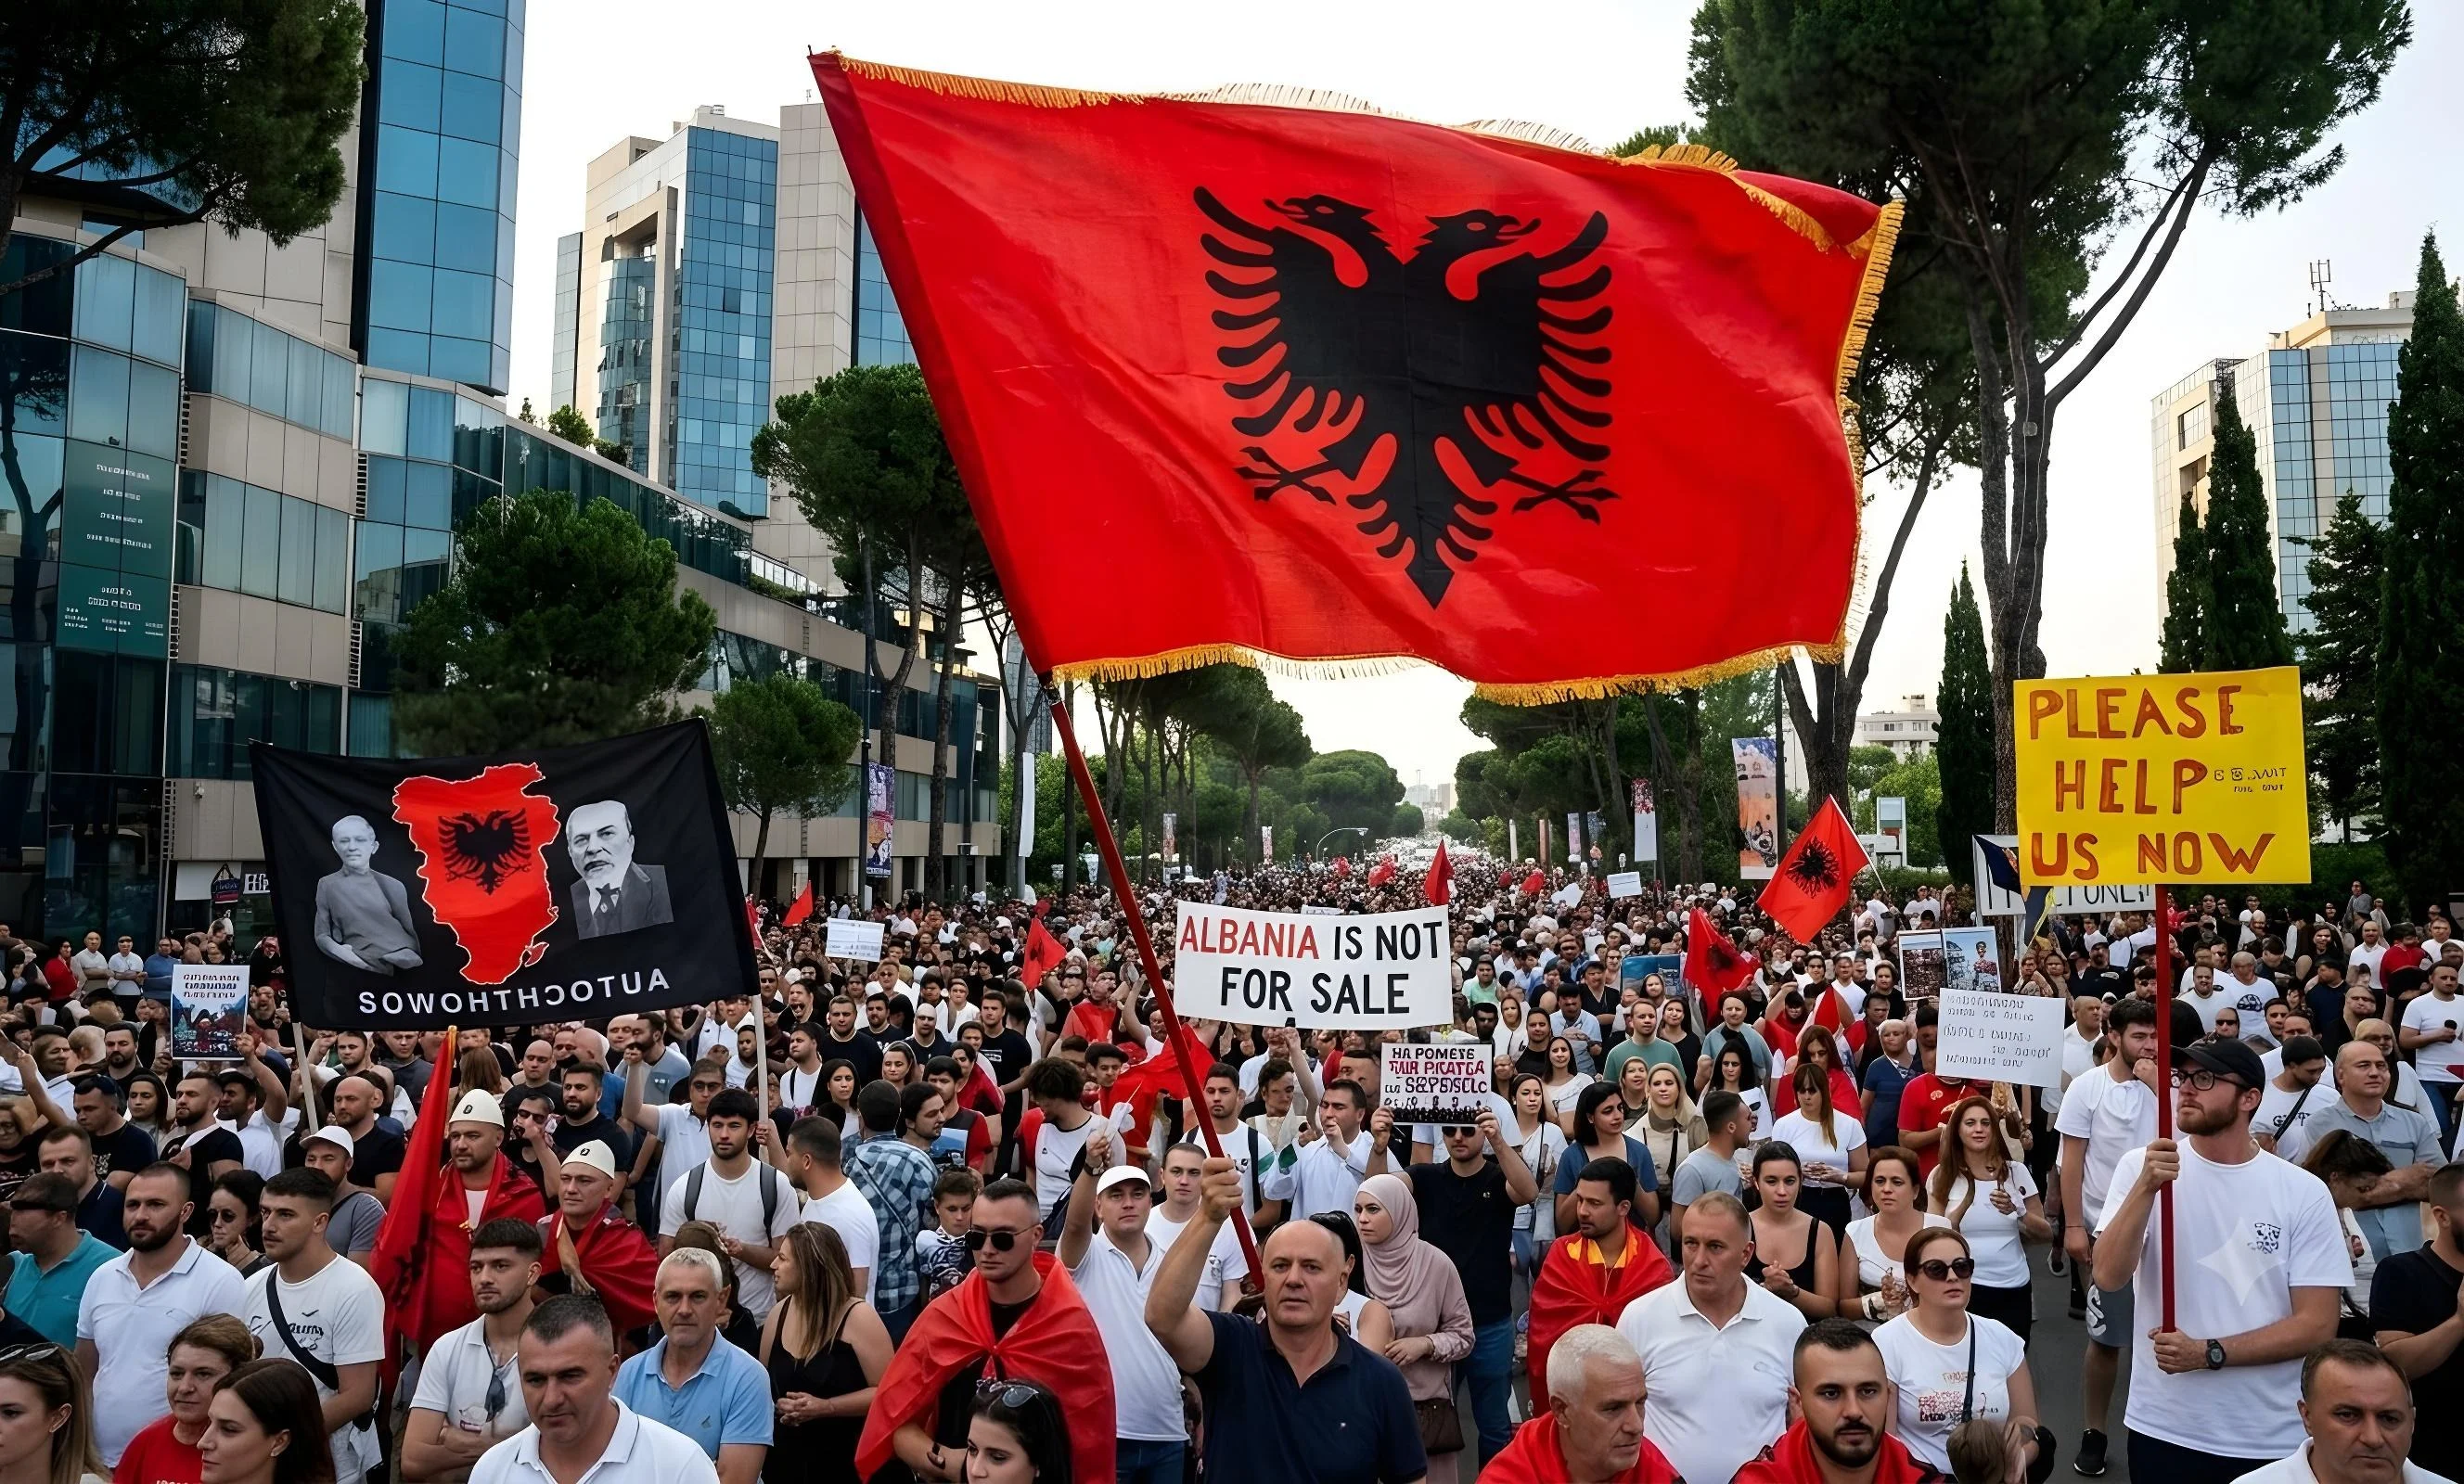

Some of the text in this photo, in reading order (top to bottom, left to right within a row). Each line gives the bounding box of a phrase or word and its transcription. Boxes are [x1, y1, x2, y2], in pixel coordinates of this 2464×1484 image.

[2029, 684, 2243, 739] PLEASE
[2055, 758, 2208, 814] HELP
[2031, 831, 2276, 880] US NOW
[1179, 915, 1443, 961] ALBANIA IS NOT
[1221, 966, 1410, 1015] FOR SALE
